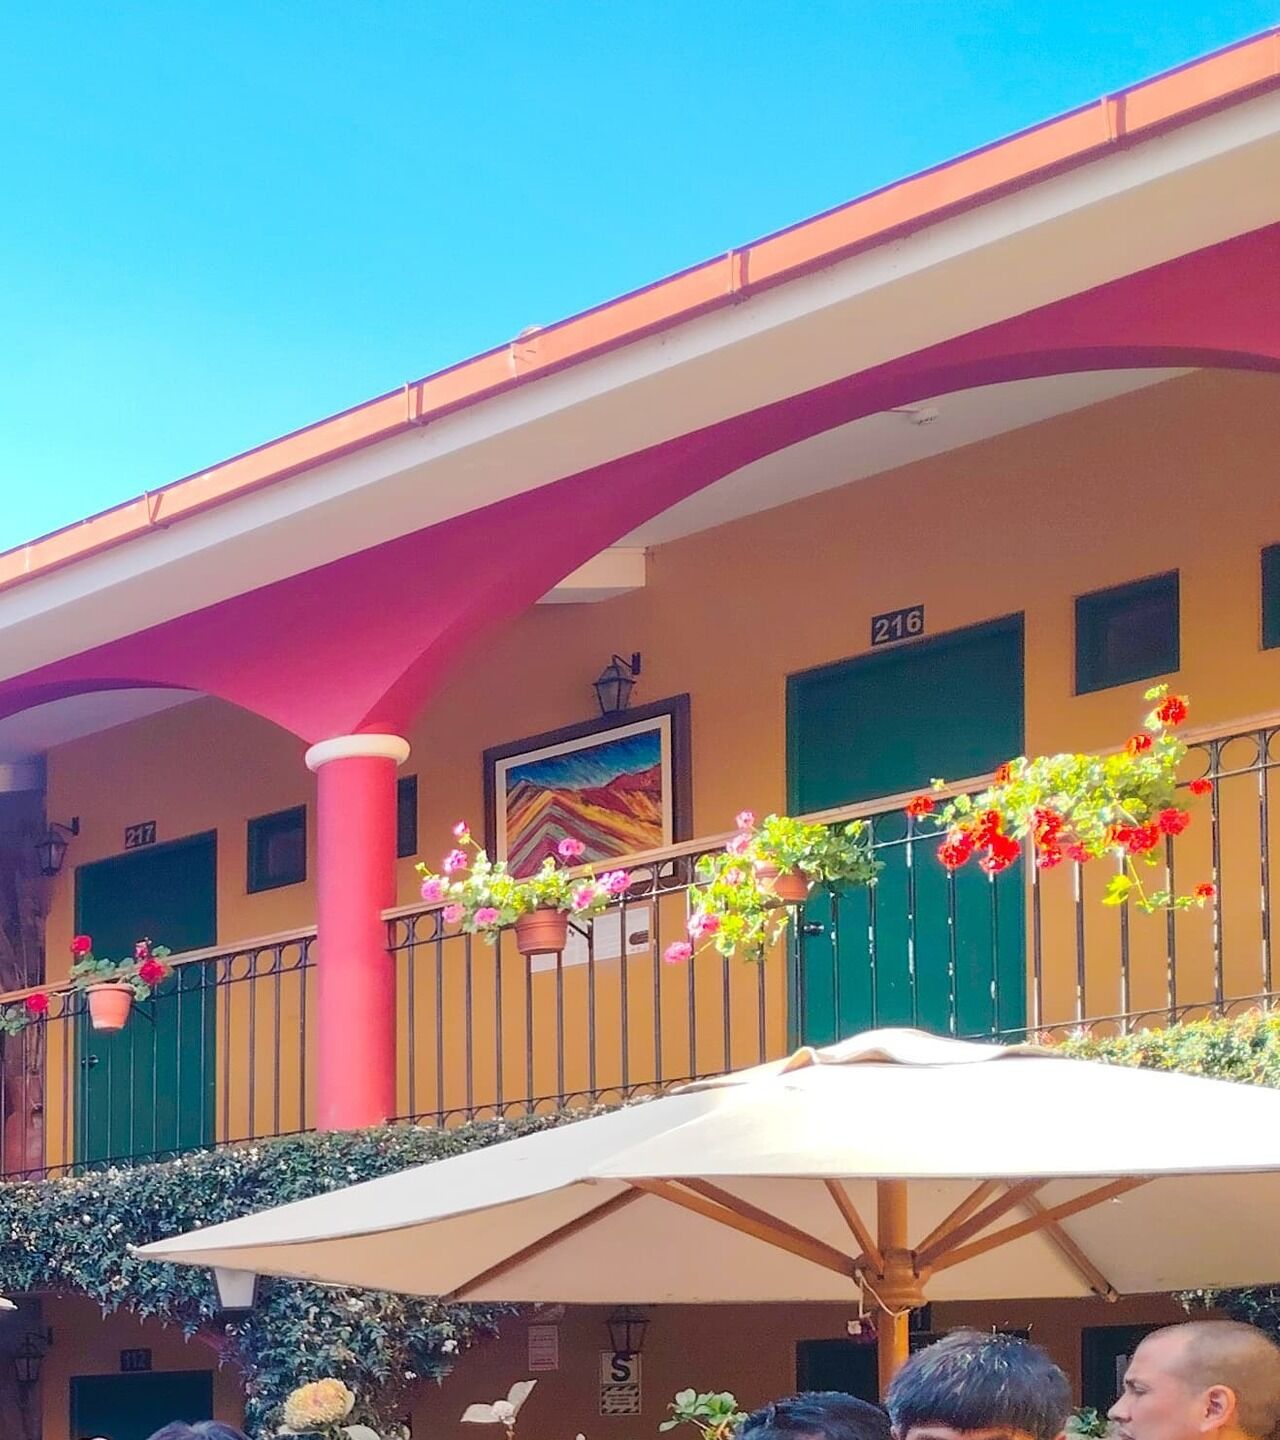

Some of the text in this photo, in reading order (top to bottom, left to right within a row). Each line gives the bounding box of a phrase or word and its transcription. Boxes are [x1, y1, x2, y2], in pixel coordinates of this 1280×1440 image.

[874, 610, 922, 643] 216
[126, 823, 154, 847] 217
[610, 1352, 633, 1382] S
